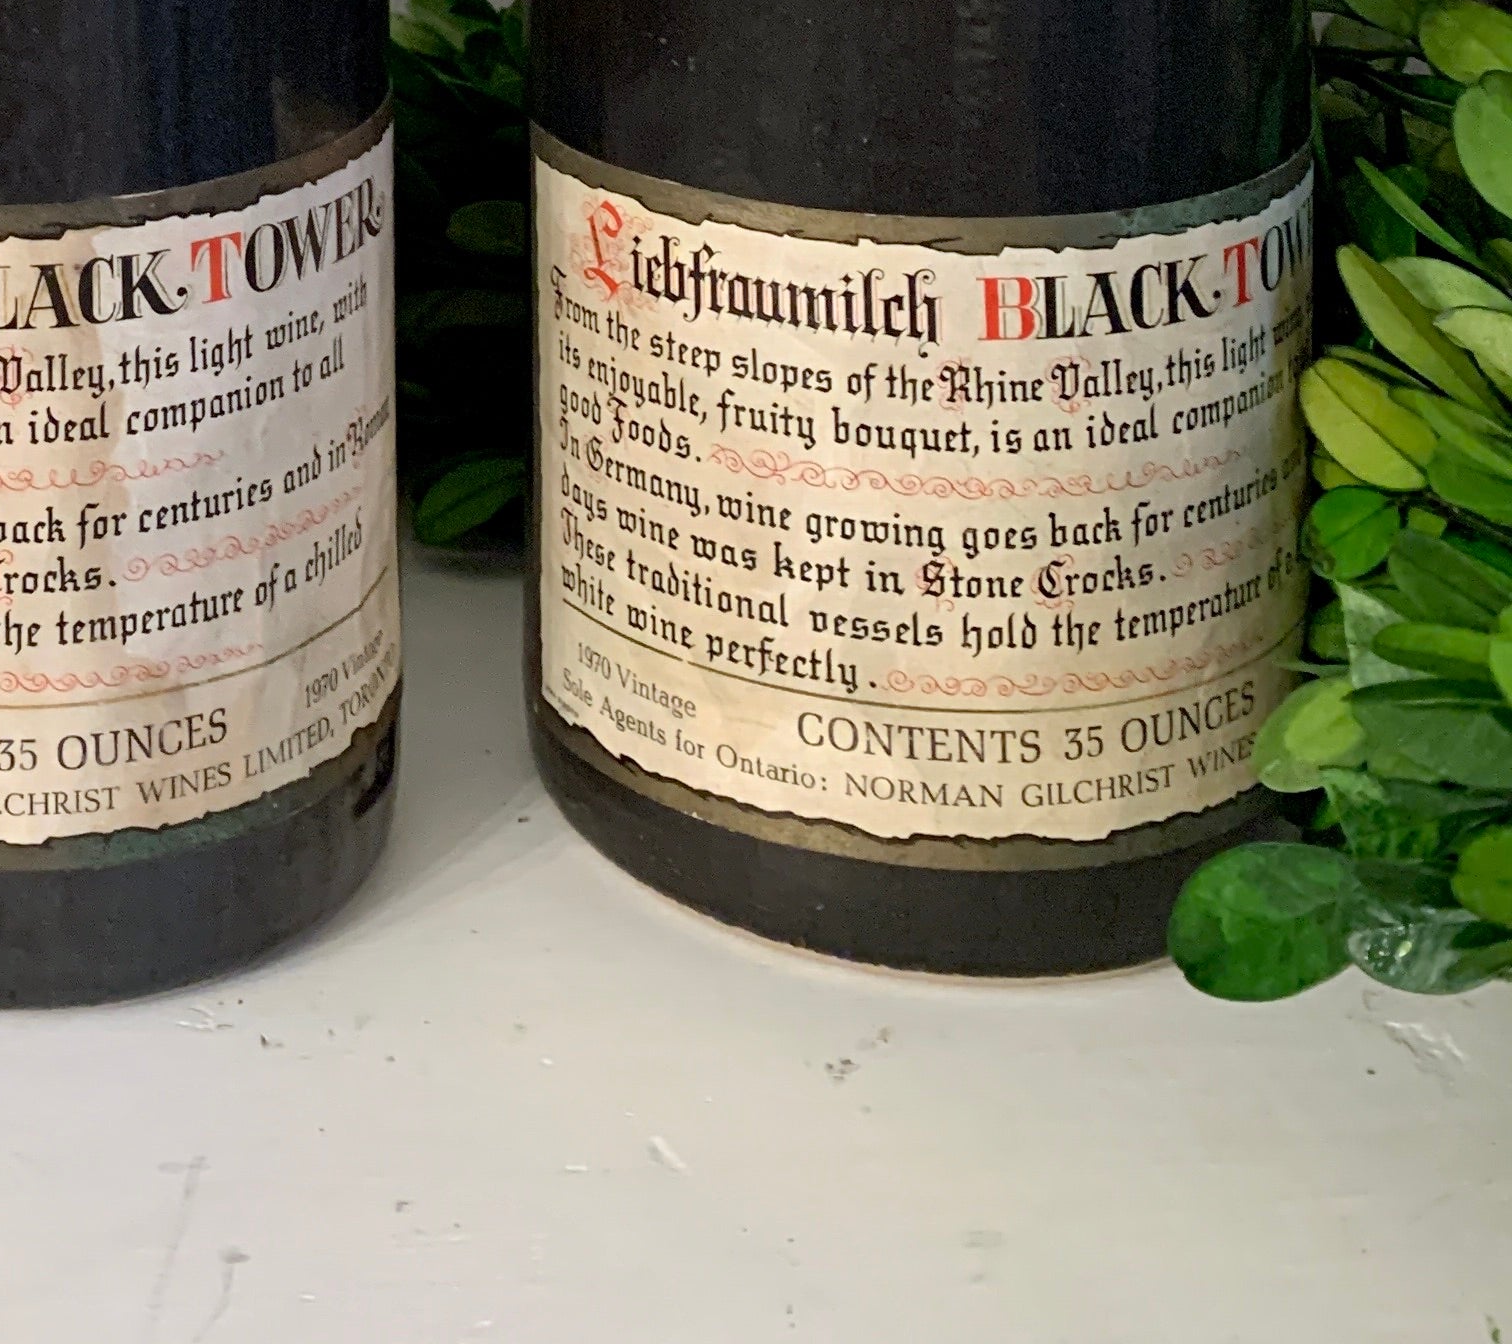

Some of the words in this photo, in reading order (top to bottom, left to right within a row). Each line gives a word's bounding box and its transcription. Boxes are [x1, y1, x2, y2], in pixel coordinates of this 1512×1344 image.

[582, 200, 940, 358] Liebfraumilch
[29, 402, 110, 445] ideal
[126, 374, 285, 432] companion
[292, 359, 313, 393] to
[320, 336, 344, 380] all
[550, 265, 601, 323] From
[607, 310, 640, 351] the
[650, 331, 721, 376] steep
[731, 349, 832, 392] slopes
[847, 362, 877, 403] of
[885, 364, 935, 407] the
[938, 365, 1044, 408] Rhine
[1051, 358, 1162, 401] Valley,
[1166, 349, 1215, 387] this
[1220, 325, 1266, 375] light
[559, 416, 581, 452] In
[585, 434, 709, 516] Germany,
[717, 491, 791, 531] wine
[805, 513, 945, 556] growing
[962, 526, 1037, 559] goes
[1049, 507, 1122, 547] back
[1131, 502, 1173, 547] for
[1183, 471, 1277, 529] centuries
[562, 564, 615, 616] white
[627, 603, 693, 649] wine
[705, 632, 877, 693] perfectly.
[577, 642, 612, 680] 1970
[617, 663, 697, 719] Vintage
[57, 707, 228, 770] OUNCES
[304, 669, 338, 709] 1970
[562, 669, 593, 707] Sole
[600, 697, 666, 745] Agents
[675, 728, 705, 759] for
[716, 744, 827, 791] Ontario:
[844, 771, 1004, 808] NORMAN
[1021, 763, 1175, 807] GILCHRIST
[797, 711, 1042, 764] CONTENTS
[1064, 725, 1104, 761] 35
[1121, 680, 1255, 754] OUNCES
[136, 762, 232, 804] WINES
[244, 715, 334, 778] LIMITED,
